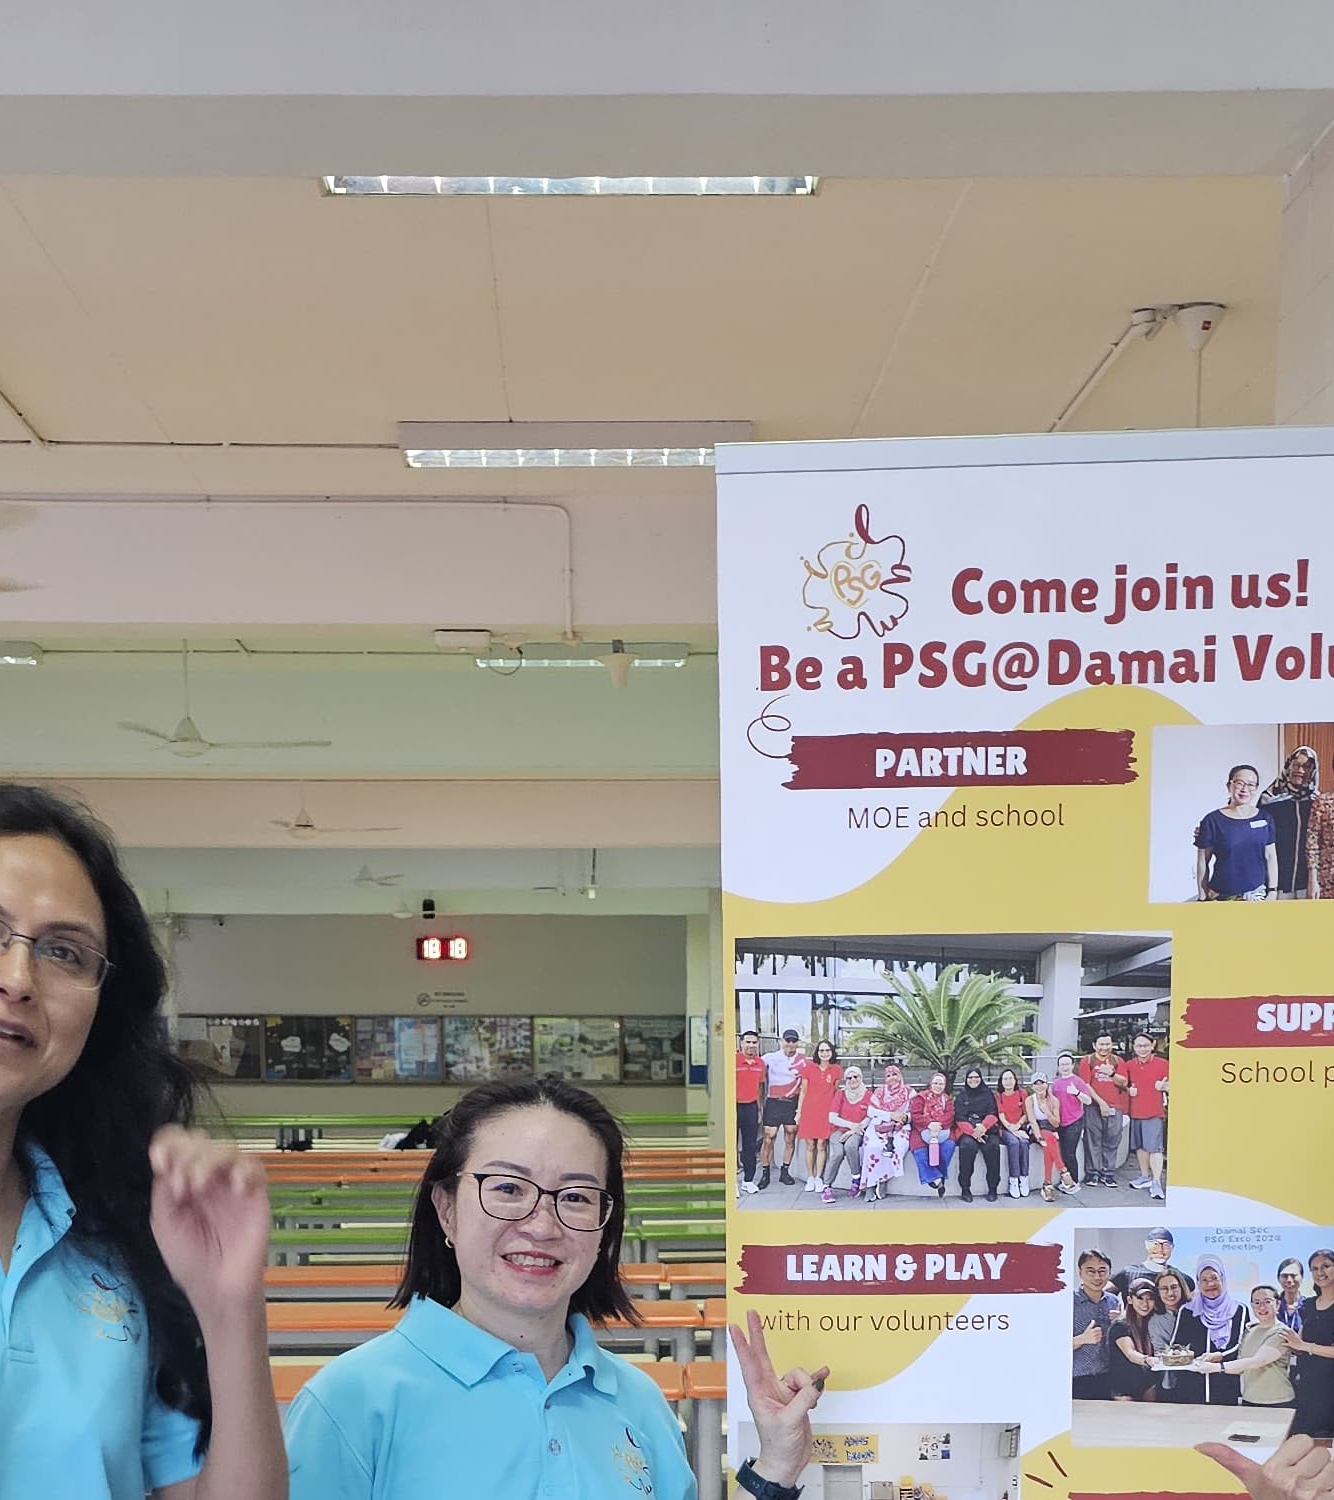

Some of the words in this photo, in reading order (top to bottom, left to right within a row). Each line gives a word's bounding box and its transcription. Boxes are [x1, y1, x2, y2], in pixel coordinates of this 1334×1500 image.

[952, 568, 1099, 615] Come
[1104, 563, 1214, 625] join
[1230, 558, 1310, 609] us!
[759, 645, 823, 692] Be
[836, 655, 868, 690] a
[883, 635, 1216, 692] PSG@Damai
[874, 746, 1028, 778] PARTNER
[847, 806, 910, 830] MOE
[917, 804, 967, 829] and
[975, 803, 1065, 827] school
[1220, 1060, 1315, 1084] School
[786, 1254, 887, 1281] LEARN
[894, 1253, 918, 1281] &
[925, 1253, 1008, 1280] PLAY
[819, 1314, 863, 1332] our
[870, 1309, 1010, 1332] volunteers
